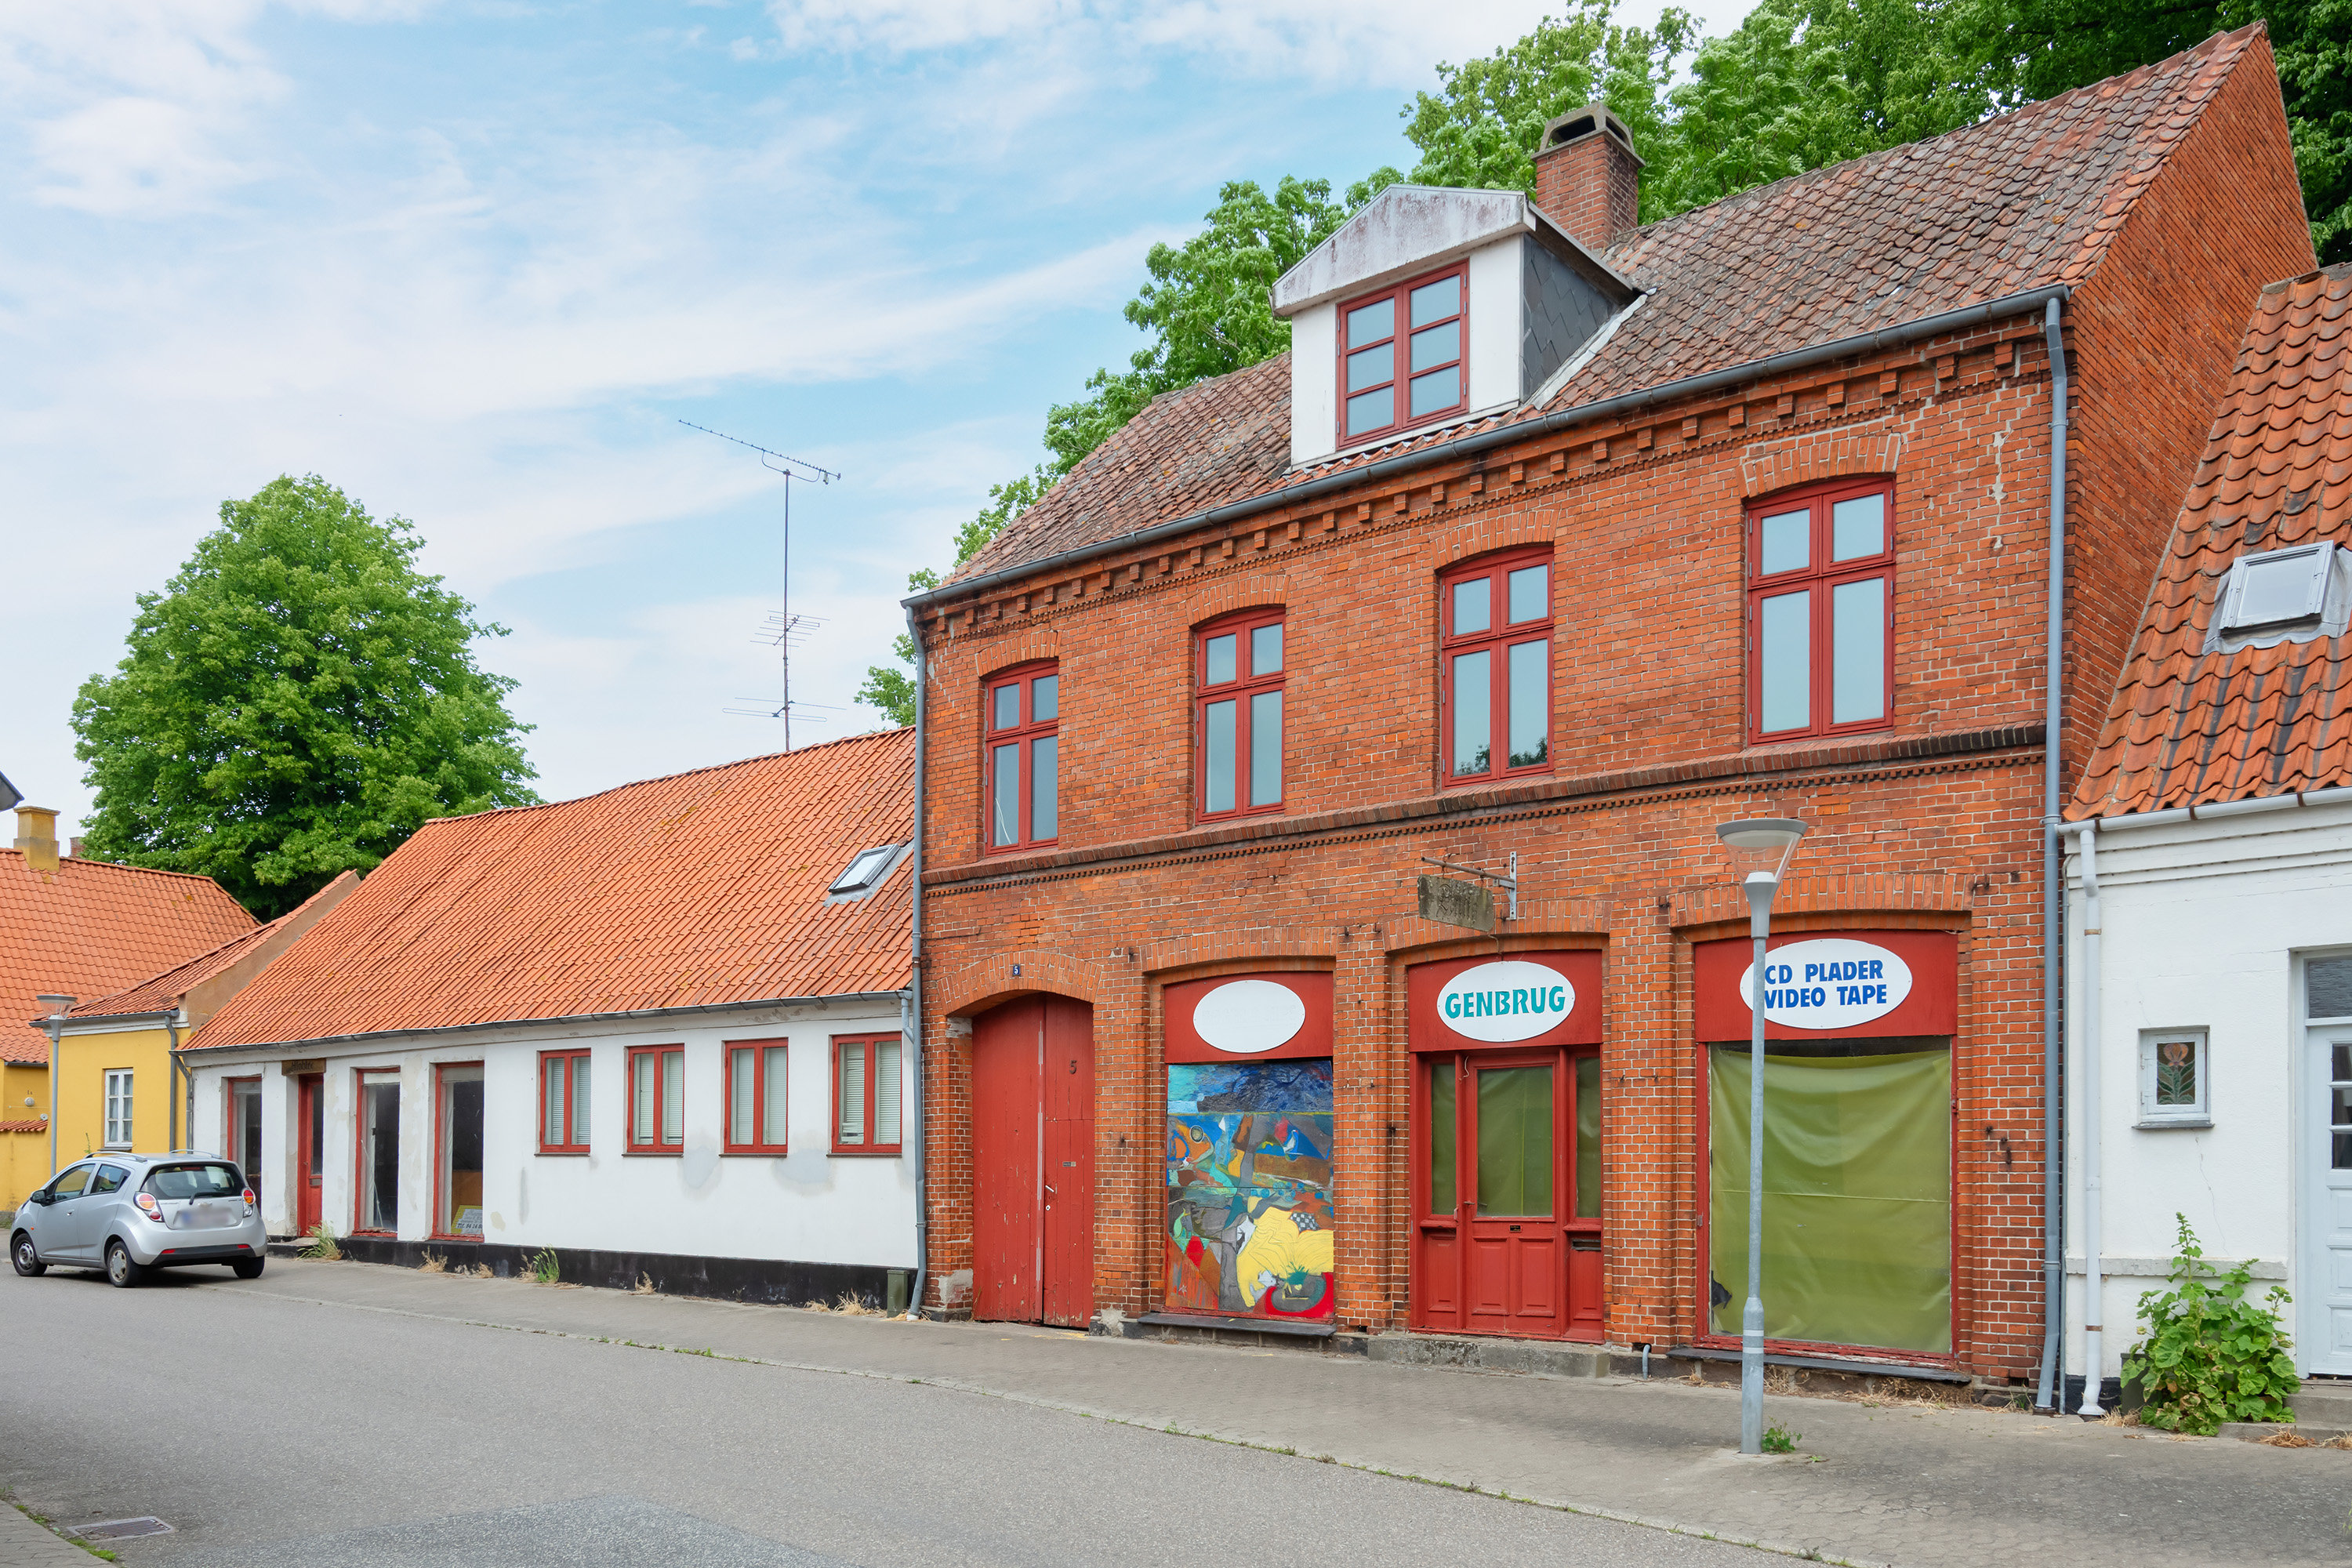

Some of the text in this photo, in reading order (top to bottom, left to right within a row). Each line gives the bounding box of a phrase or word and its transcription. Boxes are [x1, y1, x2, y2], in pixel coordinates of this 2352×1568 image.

[1765, 960, 1883, 985] CD PLADER
[1445, 985, 1566, 1019] GENBRUG
[1764, 984, 1887, 1009] VIDEO TAPE
[1069, 1059, 1077, 1075] 5
